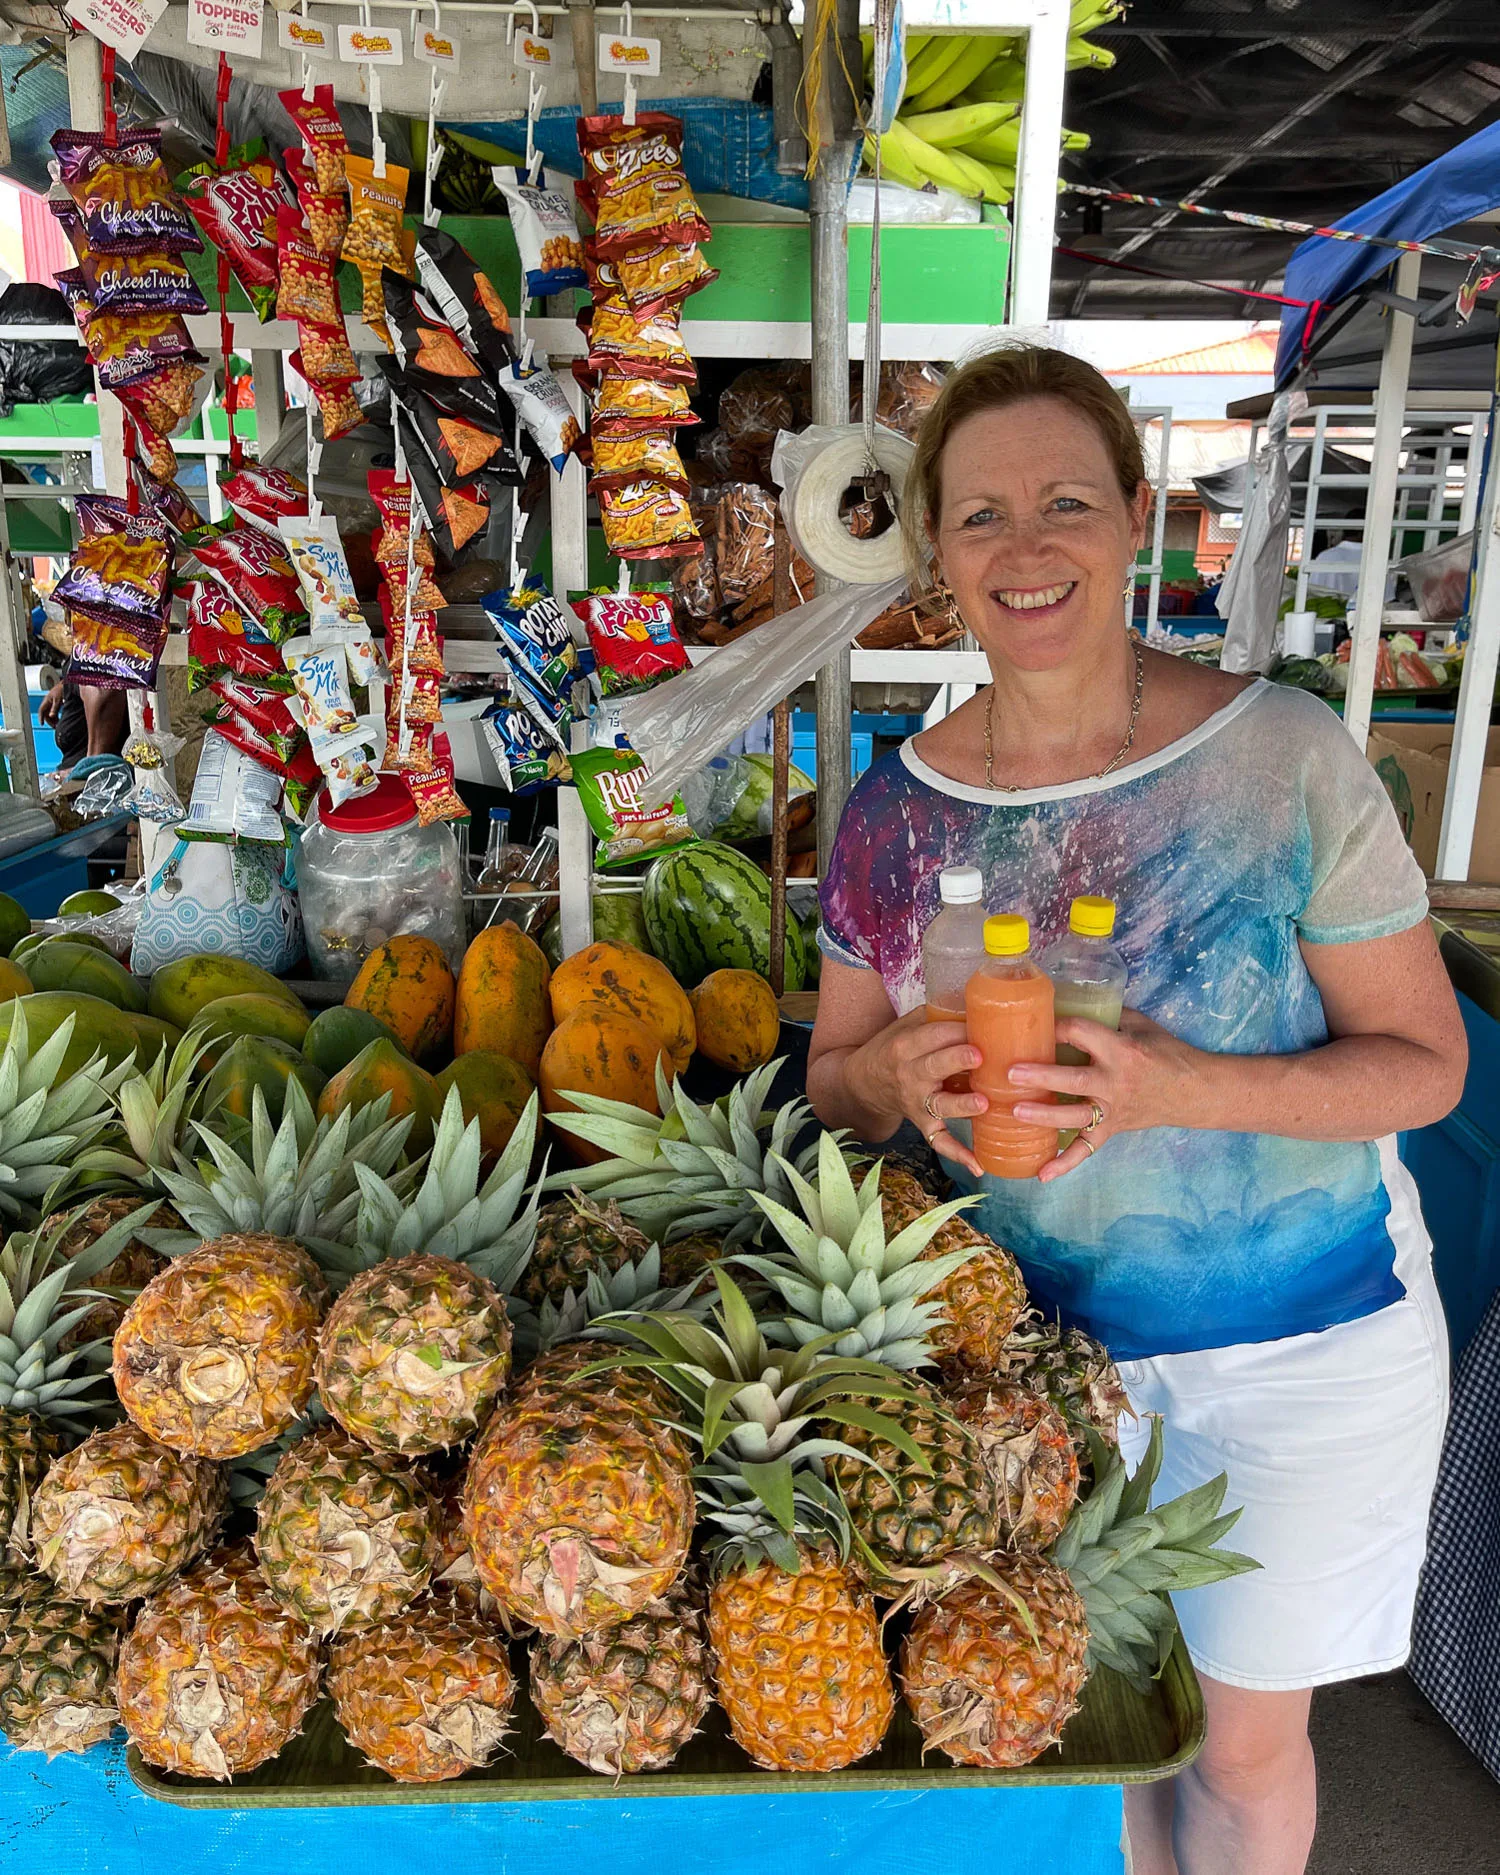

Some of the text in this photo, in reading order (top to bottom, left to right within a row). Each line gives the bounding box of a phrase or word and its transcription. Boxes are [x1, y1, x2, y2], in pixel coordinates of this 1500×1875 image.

[100, 0, 147, 36] PPERS
[194, 0, 258, 27] TOPPERS
[357, 35, 389, 48] Sunshine
[306, 122, 343, 135] Peanuts
[618, 144, 680, 180] Zees
[212, 175, 263, 213] BIG
[361, 186, 404, 209] Peanuts
[286, 240, 331, 263] Peanuts
[420, 258, 432, 268] 220
[100, 268, 193, 293] CheeseTwist
[382, 499, 411, 511] Peanu
[655, 505, 680, 515] ORIGINAL
[307, 545, 338, 562] Sun
[600, 598, 642, 614] BIG
[520, 596, 560, 647] POTAT
[545, 615, 571, 647] CHIP
[599, 604, 665, 638] FOOT
[73, 642, 153, 672] CheeseTwist
[300, 656, 335, 681] Sun
[313, 670, 340, 697] Mix
[407, 767, 447, 786] Peanuts
[527, 765, 544, 775] Nacho
[426, 779, 439, 788] CON
[594, 765, 652, 816] Ripp
[621, 814, 638, 822] 100%
